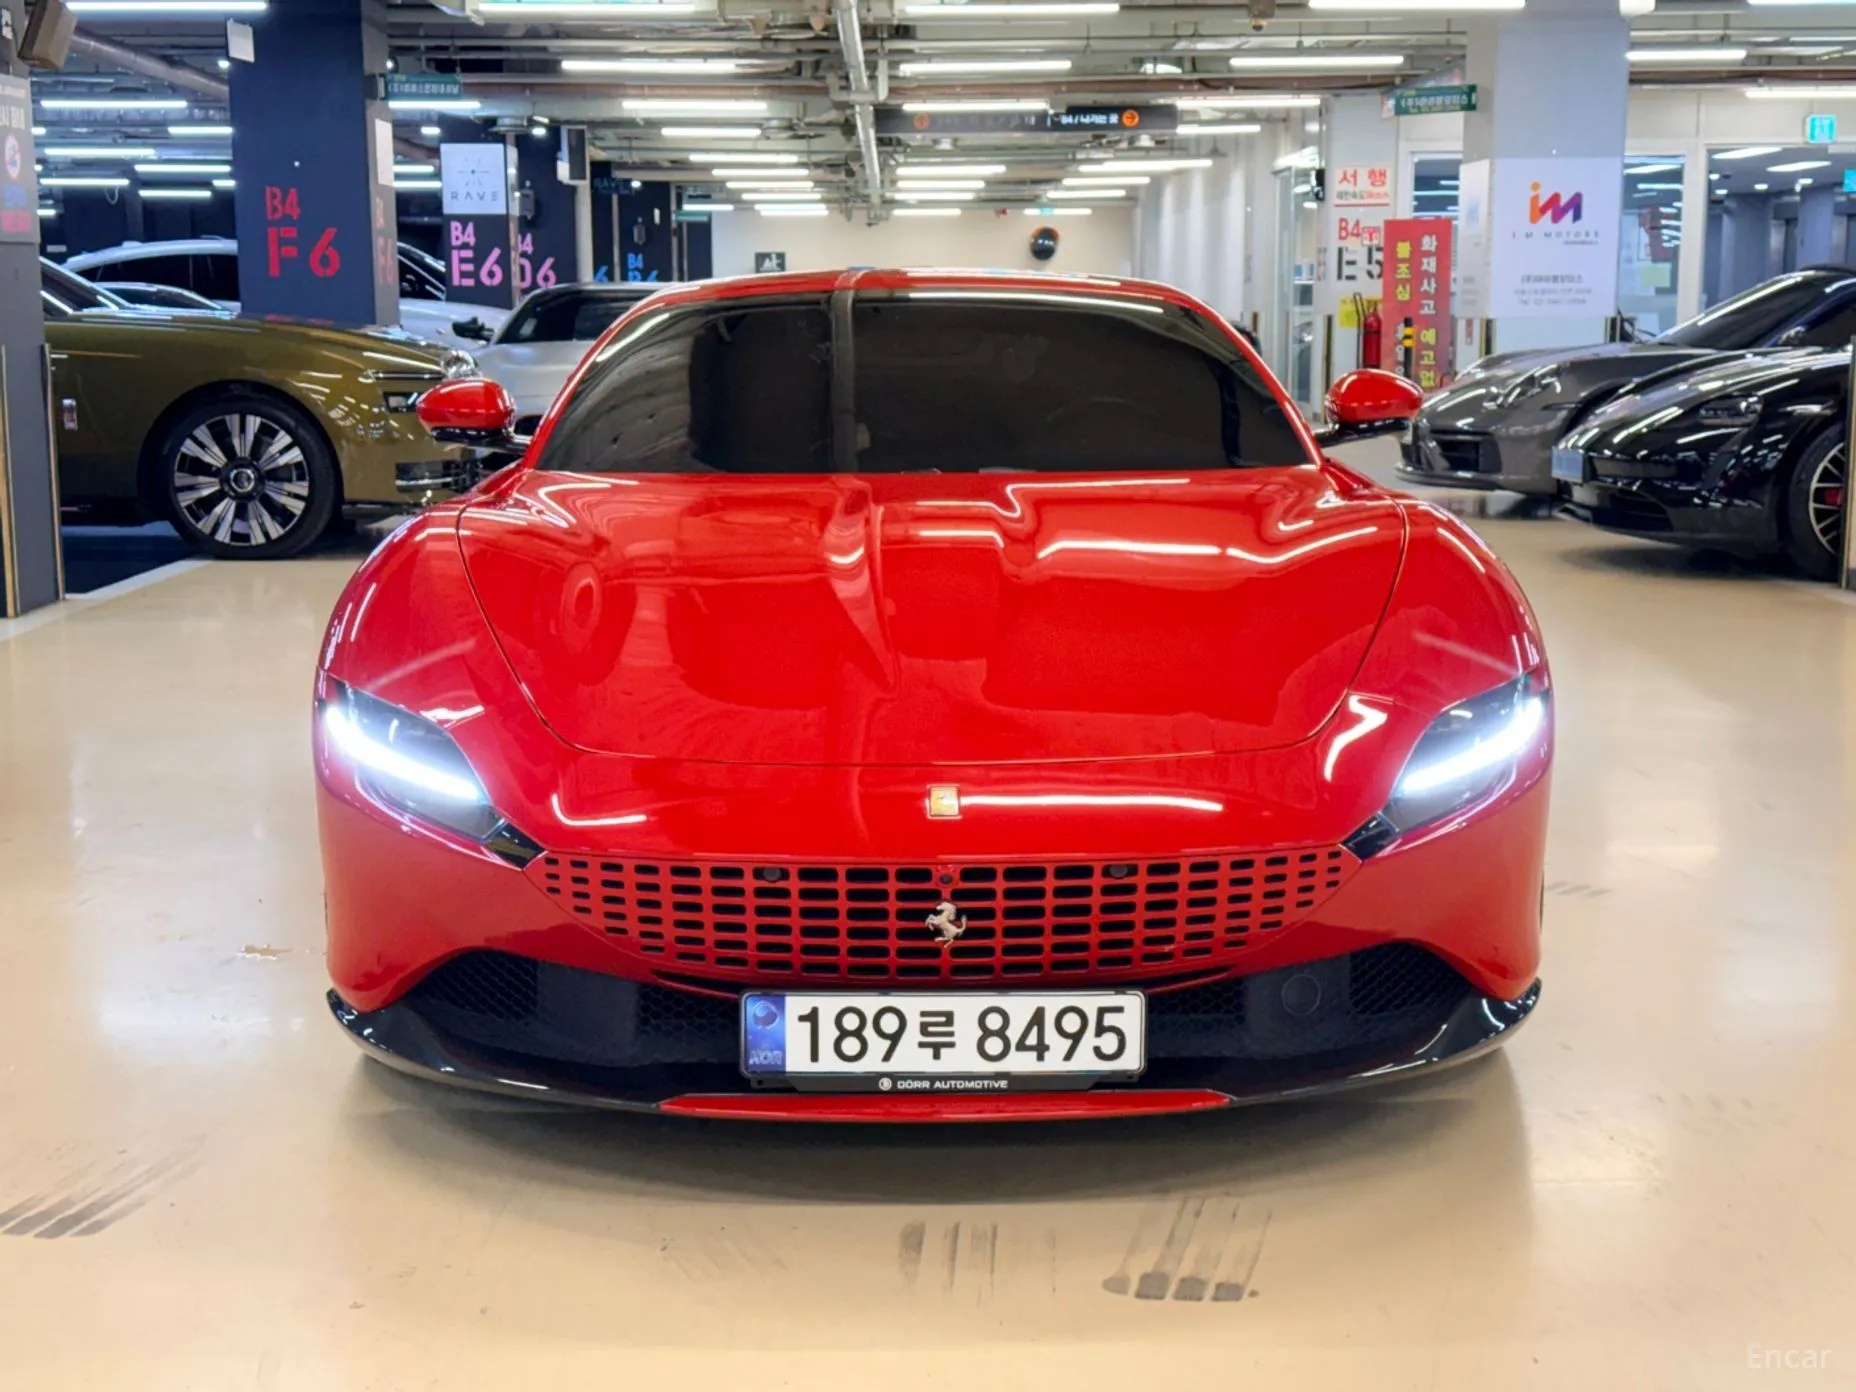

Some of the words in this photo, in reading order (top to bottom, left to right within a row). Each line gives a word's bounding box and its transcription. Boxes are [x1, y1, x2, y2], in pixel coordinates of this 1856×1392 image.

[265, 186, 300, 220] B4
[450, 190, 498, 201] RAVE
[450, 220, 476, 246] B4
[1338, 218, 1360, 240] B4
[518, 233, 534, 255] 4
[451, 247, 504, 287] E6
[797, 1006, 956, 1063] 189루
[976, 1006, 1127, 1062] 8495
[897, 1078, 930, 1089] DÖRR
[933, 1079, 1008, 1089] AUTOMOTIVE
